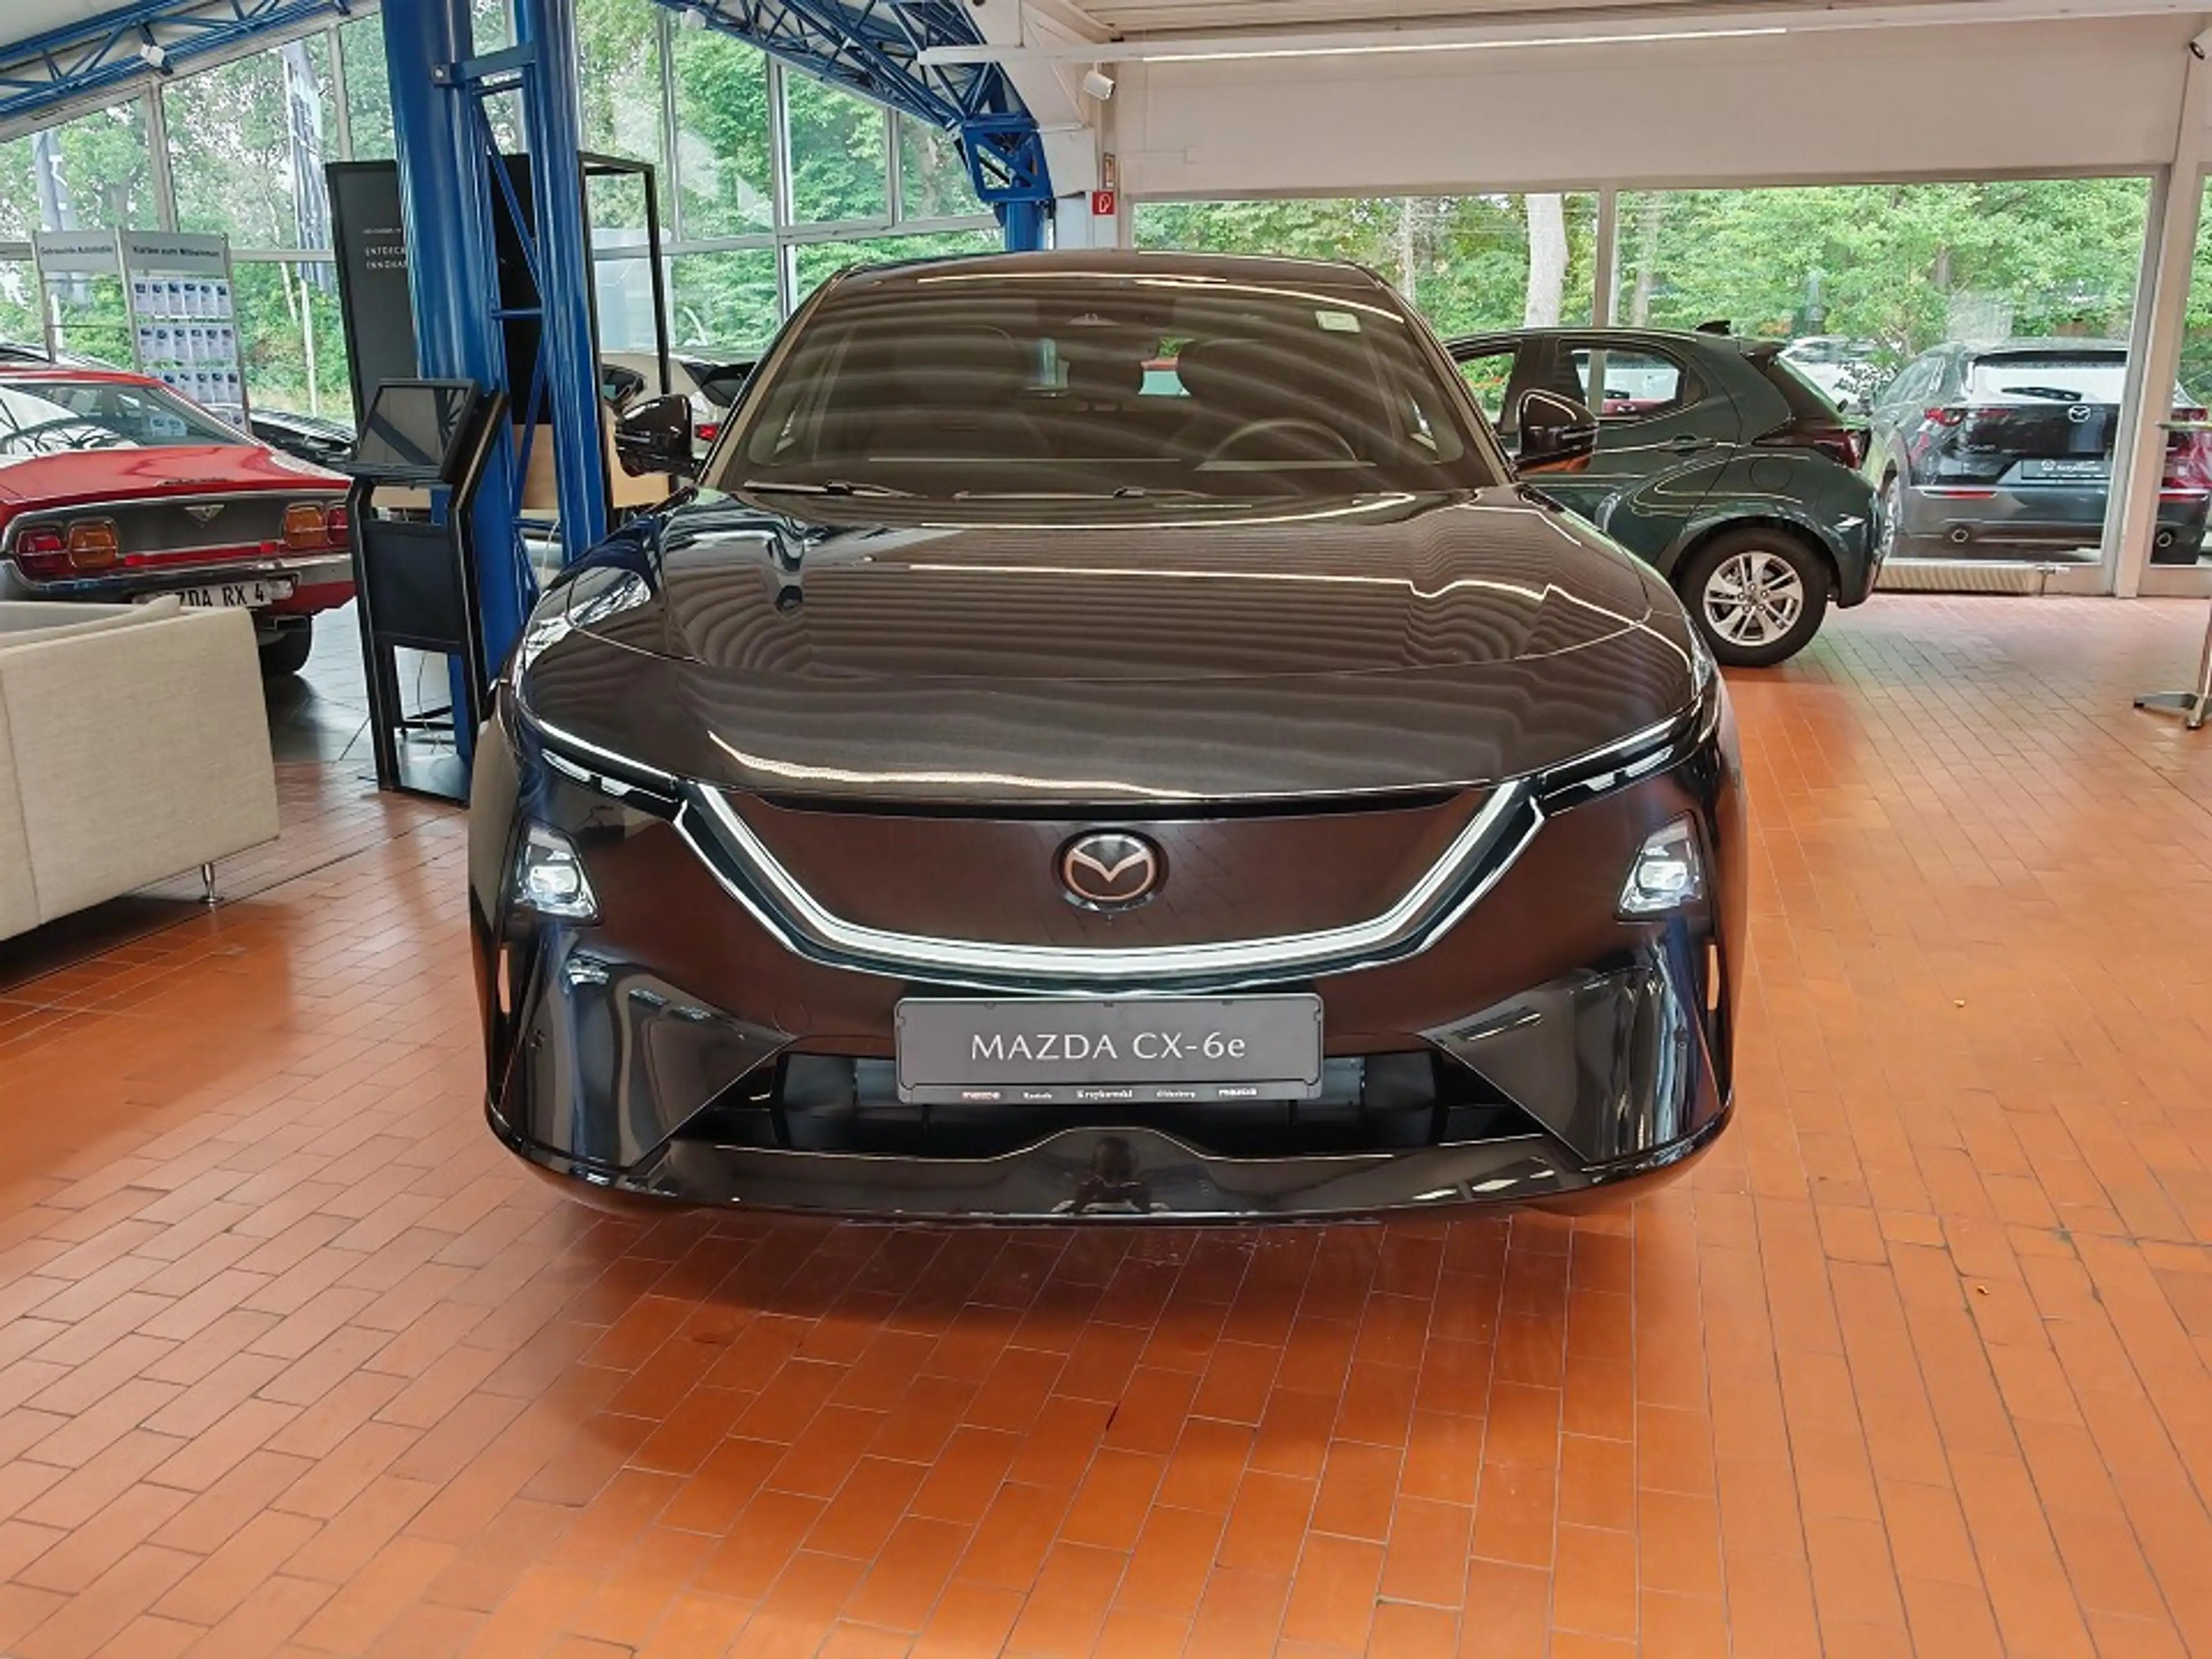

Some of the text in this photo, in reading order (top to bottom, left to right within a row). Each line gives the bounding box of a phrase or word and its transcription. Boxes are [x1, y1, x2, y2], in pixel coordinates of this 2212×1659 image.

[171, 583, 264, 607] ZDA RX 4
[972, 1031, 1246, 1060] MAZDA CX-6e
